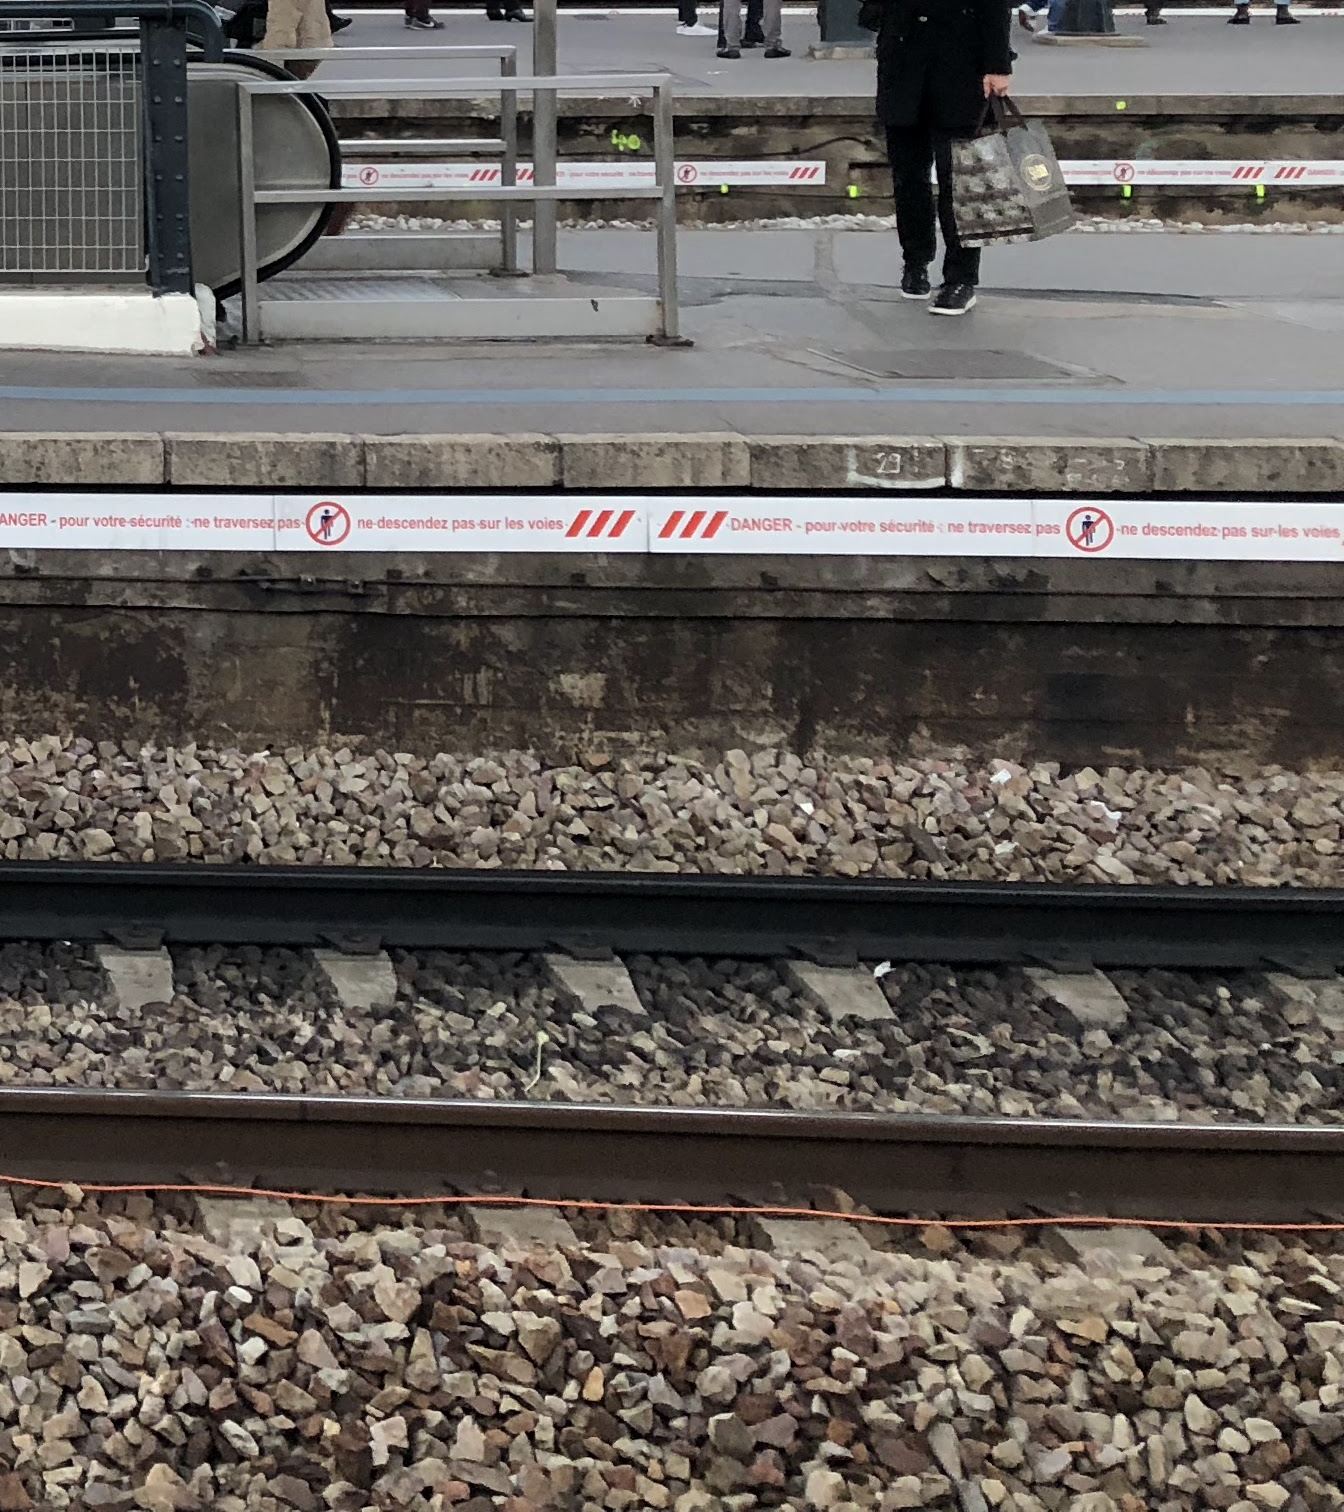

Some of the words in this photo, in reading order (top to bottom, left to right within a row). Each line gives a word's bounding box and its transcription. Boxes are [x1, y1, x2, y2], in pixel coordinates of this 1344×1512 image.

[59, 517, 88, 529] pour
[93, 515, 128, 527] votre
[129, 515, 182, 528] sécurité
[192, 518, 210, 528] ne
[213, 516, 274, 529] traversez
[277, 519, 302, 532] pas
[358, 519, 375, 529] ne
[377, 517, 448, 529] descendez
[452, 520, 475, 532] pas
[477, 520, 501, 529] sur
[505, 517, 524, 529] les
[528, 517, 563, 530] voies
[731, 518, 792, 531] DANGER
[805, 522, 837, 534] pour
[841, 520, 875, 532] votre
[879, 520, 934, 533] sécurité
[948, 523, 964, 533] ne
[968, 522, 1032, 534] traversez
[1036, 524, 1060, 536] pas
[1120, 525, 1138, 535] ne
[1142, 523, 1217, 536] descendez
[1222, 527, 1247, 540] pas
[1251, 527, 1275, 537] sur
[1278, 525, 1299, 537] les
[1302, 526, 1341, 539] voies
